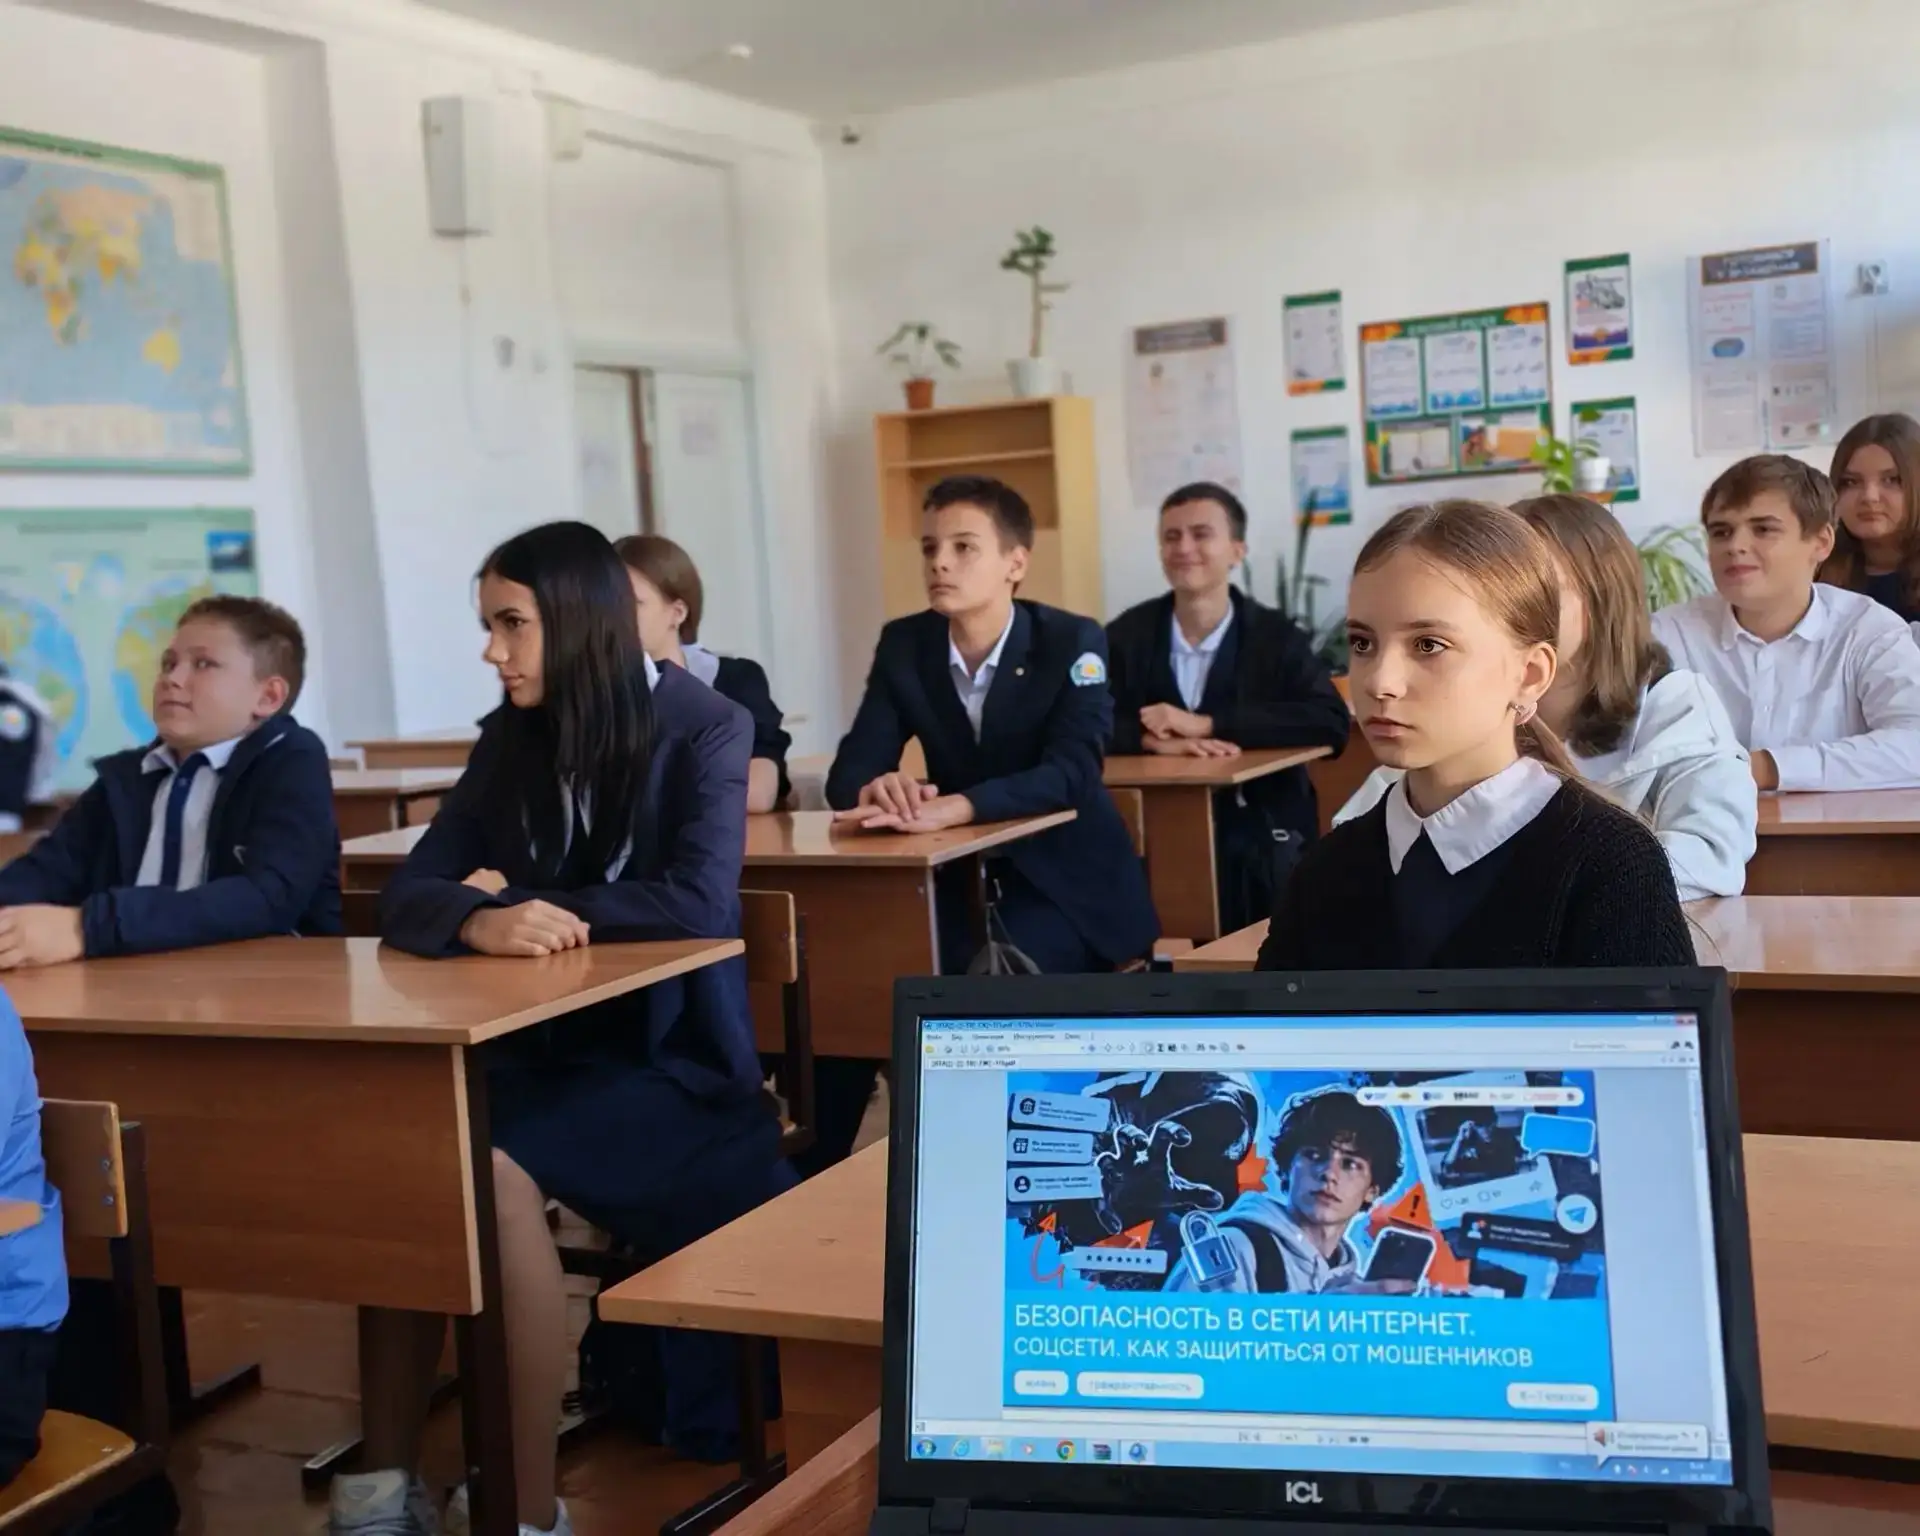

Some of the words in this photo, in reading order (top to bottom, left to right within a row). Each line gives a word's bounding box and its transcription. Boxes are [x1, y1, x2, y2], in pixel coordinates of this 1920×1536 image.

[1015, 1304, 1221, 1331] БЕЗОПАСНОСТЬ
[1228, 1308, 1244, 1331] В
[1251, 1308, 1321, 1333] СЕТИ
[1328, 1310, 1477, 1337] ИНТЕРНЕТ.
[1014, 1336, 1121, 1360] СОЦСЕТИ.
[1127, 1339, 1169, 1359] КАК
[1175, 1340, 1326, 1364] ЗАЩИТИТЬСЯ
[1331, 1343, 1361, 1364] ОТ
[1367, 1343, 1534, 1368] МОШЕННИКОВ
[1285, 1481, 1325, 1504] ICL
